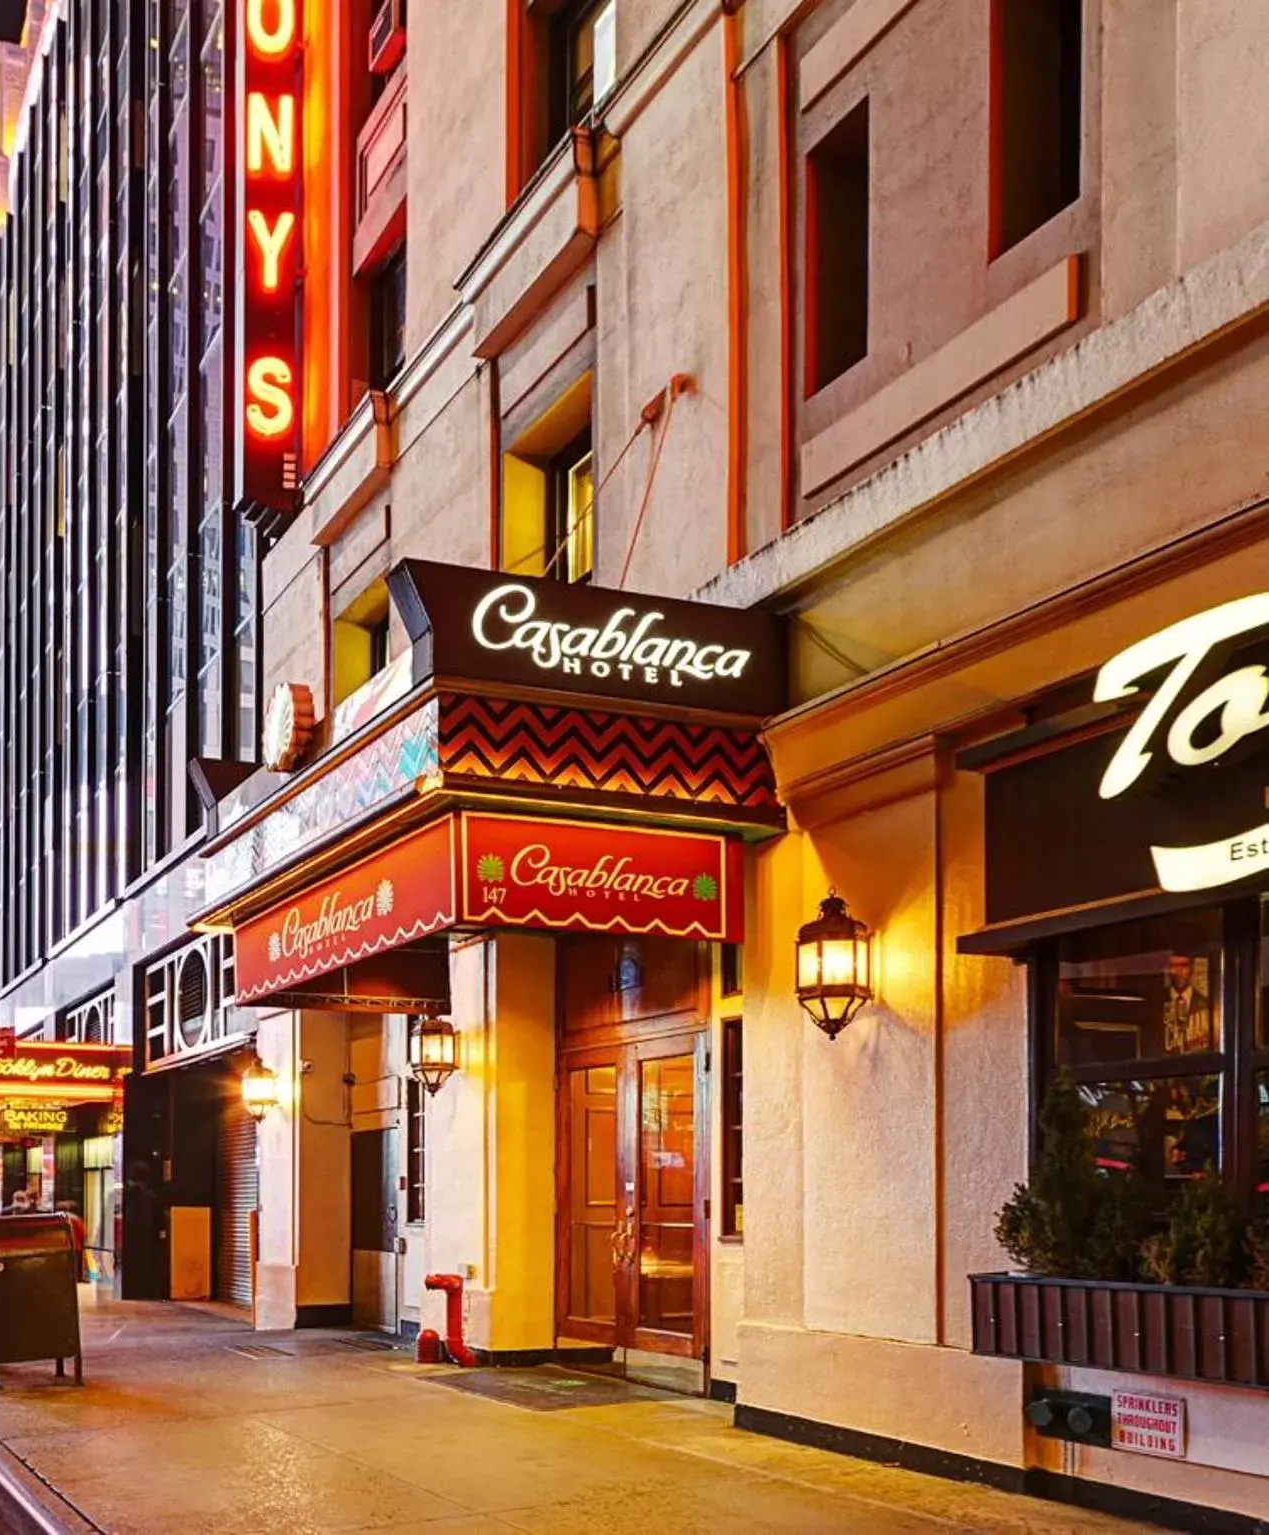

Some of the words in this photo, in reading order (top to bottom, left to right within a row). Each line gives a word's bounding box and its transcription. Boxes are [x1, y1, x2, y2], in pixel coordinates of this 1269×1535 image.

[472, 584, 751, 680] Casablanca
[562, 656, 684, 687] HOTEL
[510, 843, 689, 899] Casablanca
[482, 886, 507, 904] 147
[567, 888, 641, 902] HOTEL
[282, 891, 375, 959] Casablanca
[56, 1057, 110, 1079] Diner
[4, 1109, 68, 1123] BAKING
[1116, 1394, 1178, 1417] SPRINKLERS
